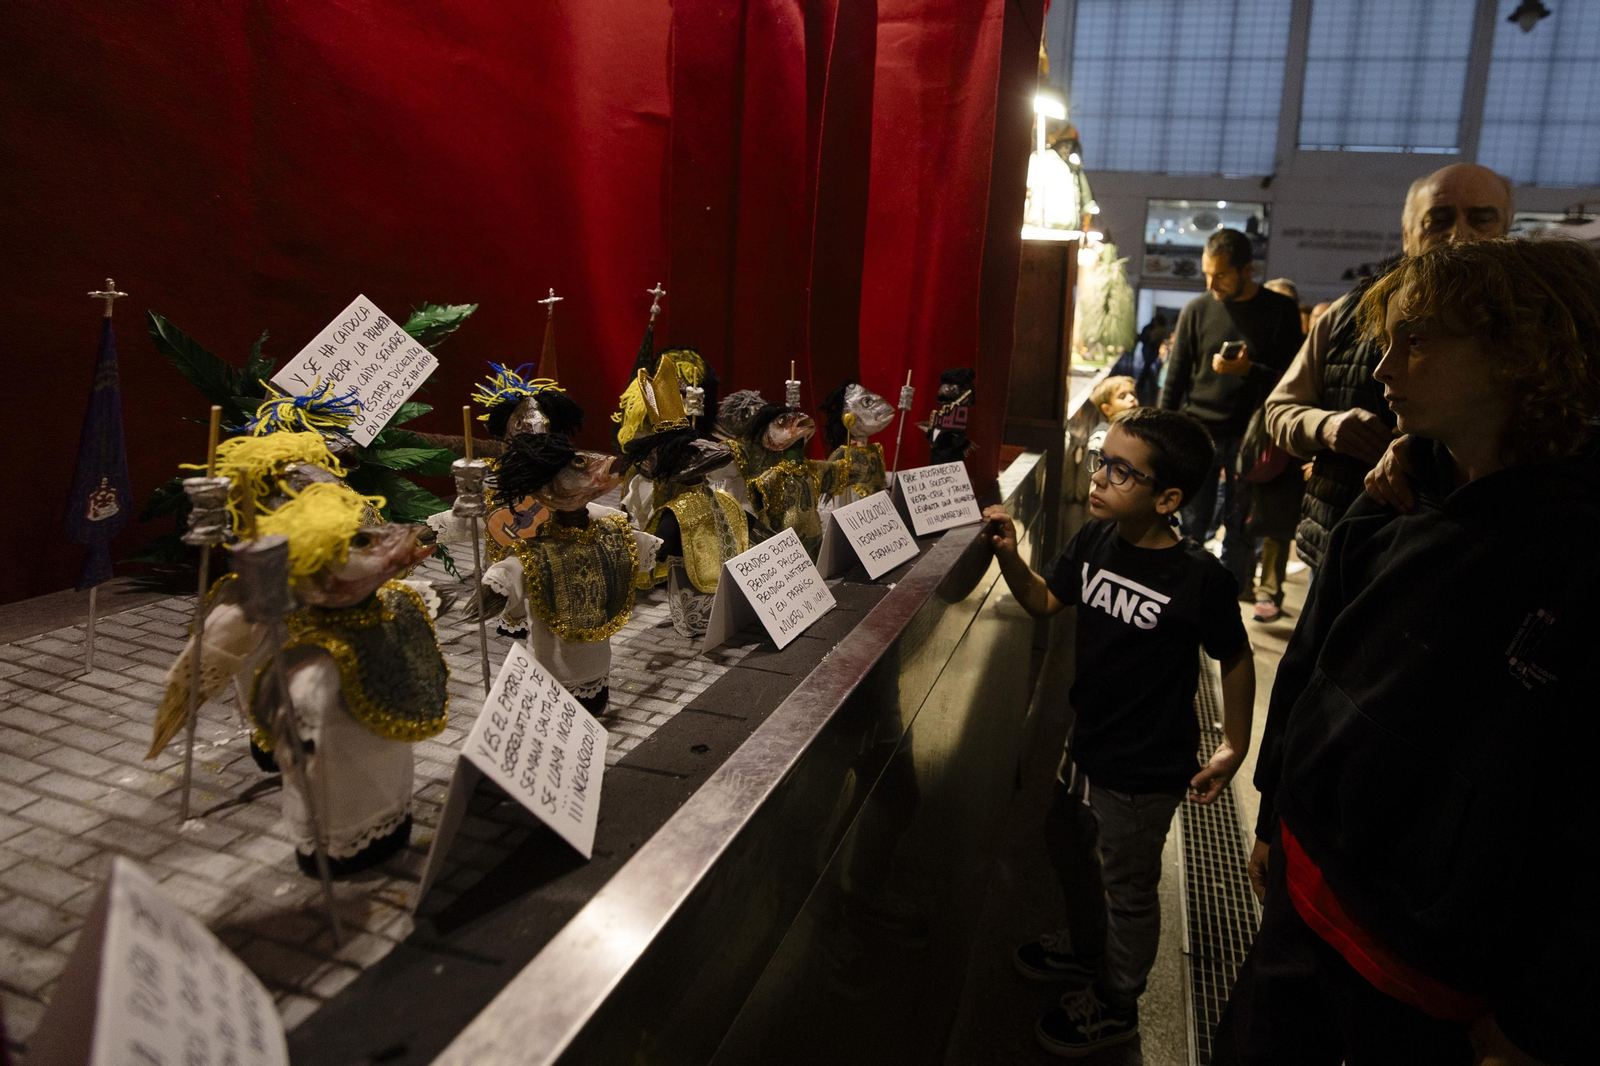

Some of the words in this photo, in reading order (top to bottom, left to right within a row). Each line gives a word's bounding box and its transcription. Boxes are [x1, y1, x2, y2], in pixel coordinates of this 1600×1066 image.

[289, 373, 309, 387] Y
[303, 357, 321, 376] SE
[318, 344, 337, 358] HA
[355, 306, 370, 322] LA
[311, 359, 359, 397] ALMERA,
[353, 341, 369, 356] LA
[363, 315, 391, 341] PALMERA
[345, 385, 361, 399] HA
[363, 381, 393, 413] ESTABA
[365, 421, 380, 437] EN
[402, 377, 413, 389] SE
[408, 369, 419, 380] HA
[903, 472, 917, 483] QUE
[907, 485, 917, 494] EN
[919, 482, 926, 491] LA
[946, 487, 952, 496] Y
[735, 553, 770, 577] BENDIGO
[747, 567, 777, 592] BENDIGO
[756, 580, 785, 604] BENDIGO
[1081, 561, 1171, 629] VANS
[768, 607, 778, 621] Y
[775, 599, 788, 612] EN
[779, 609, 804, 635] MUERO
[498, 656, 528, 713] EMBRUJO
[529, 668, 544, 687] DE
[492, 710, 508, 731] EL
[483, 727, 502, 752] ES
[519, 737, 544, 797] SEMANA
[534, 699, 555, 738] SANTA
[477, 744, 496, 764] Y
[548, 745, 565, 789] LLAMA
[541, 786, 557, 815] SE
